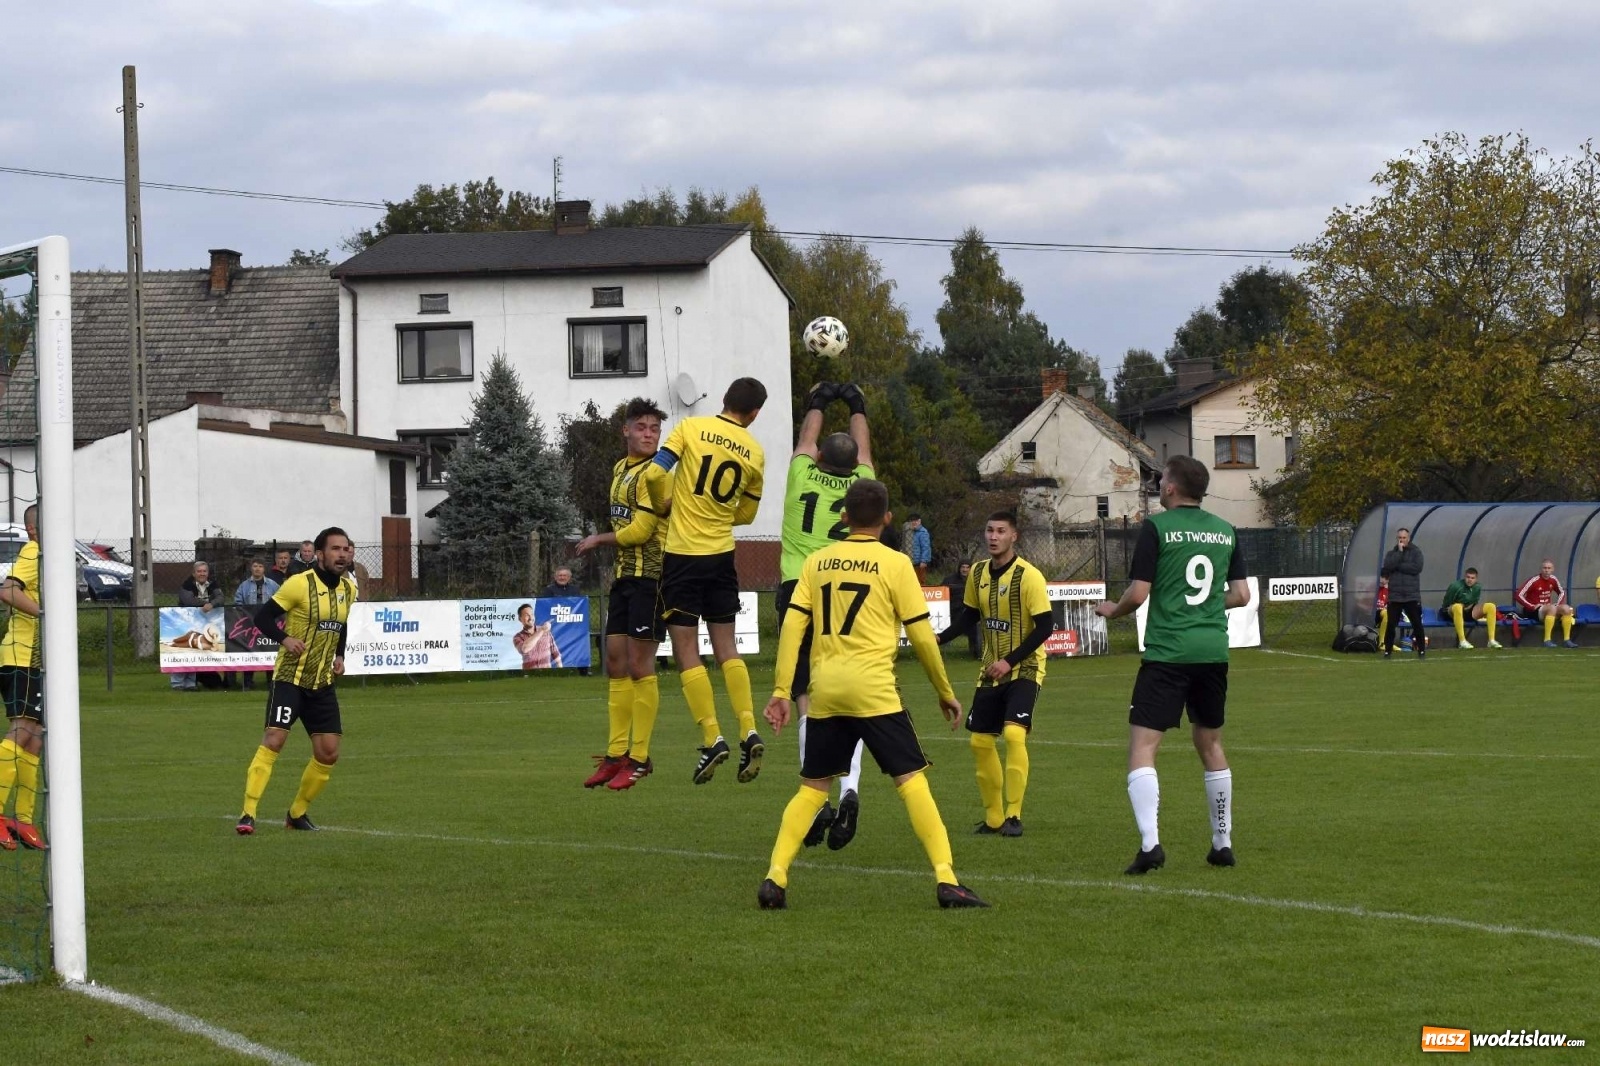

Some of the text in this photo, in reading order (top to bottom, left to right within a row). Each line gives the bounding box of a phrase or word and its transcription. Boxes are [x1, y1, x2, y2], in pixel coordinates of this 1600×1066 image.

[700, 431, 750, 460] LUBOMIA
[693, 455, 742, 504] 10
[808, 472, 852, 490] LUBOMI
[1165, 531, 1232, 546] LKS TWORKÓW
[817, 558, 879, 575] LUBOMIA
[1184, 554, 1214, 606] 9
[1059, 587, 1103, 596] BUDOWLANE
[1272, 583, 1335, 596] GOSPODARZE
[464, 604, 497, 613] Podejmij
[820, 581, 871, 636] 17
[464, 612, 516, 621] dobrą decyzję
[469, 622, 493, 630] pracuj
[1048, 633, 1071, 641] NAJEM
[369, 642, 389, 651] SMS
[398, 641, 422, 650] treści
[424, 640, 449, 649] PRACA
[1045, 641, 1076, 651] LUNKÓW
[363, 653, 429, 667] 538 622 330
[275, 705, 292, 724] 13
